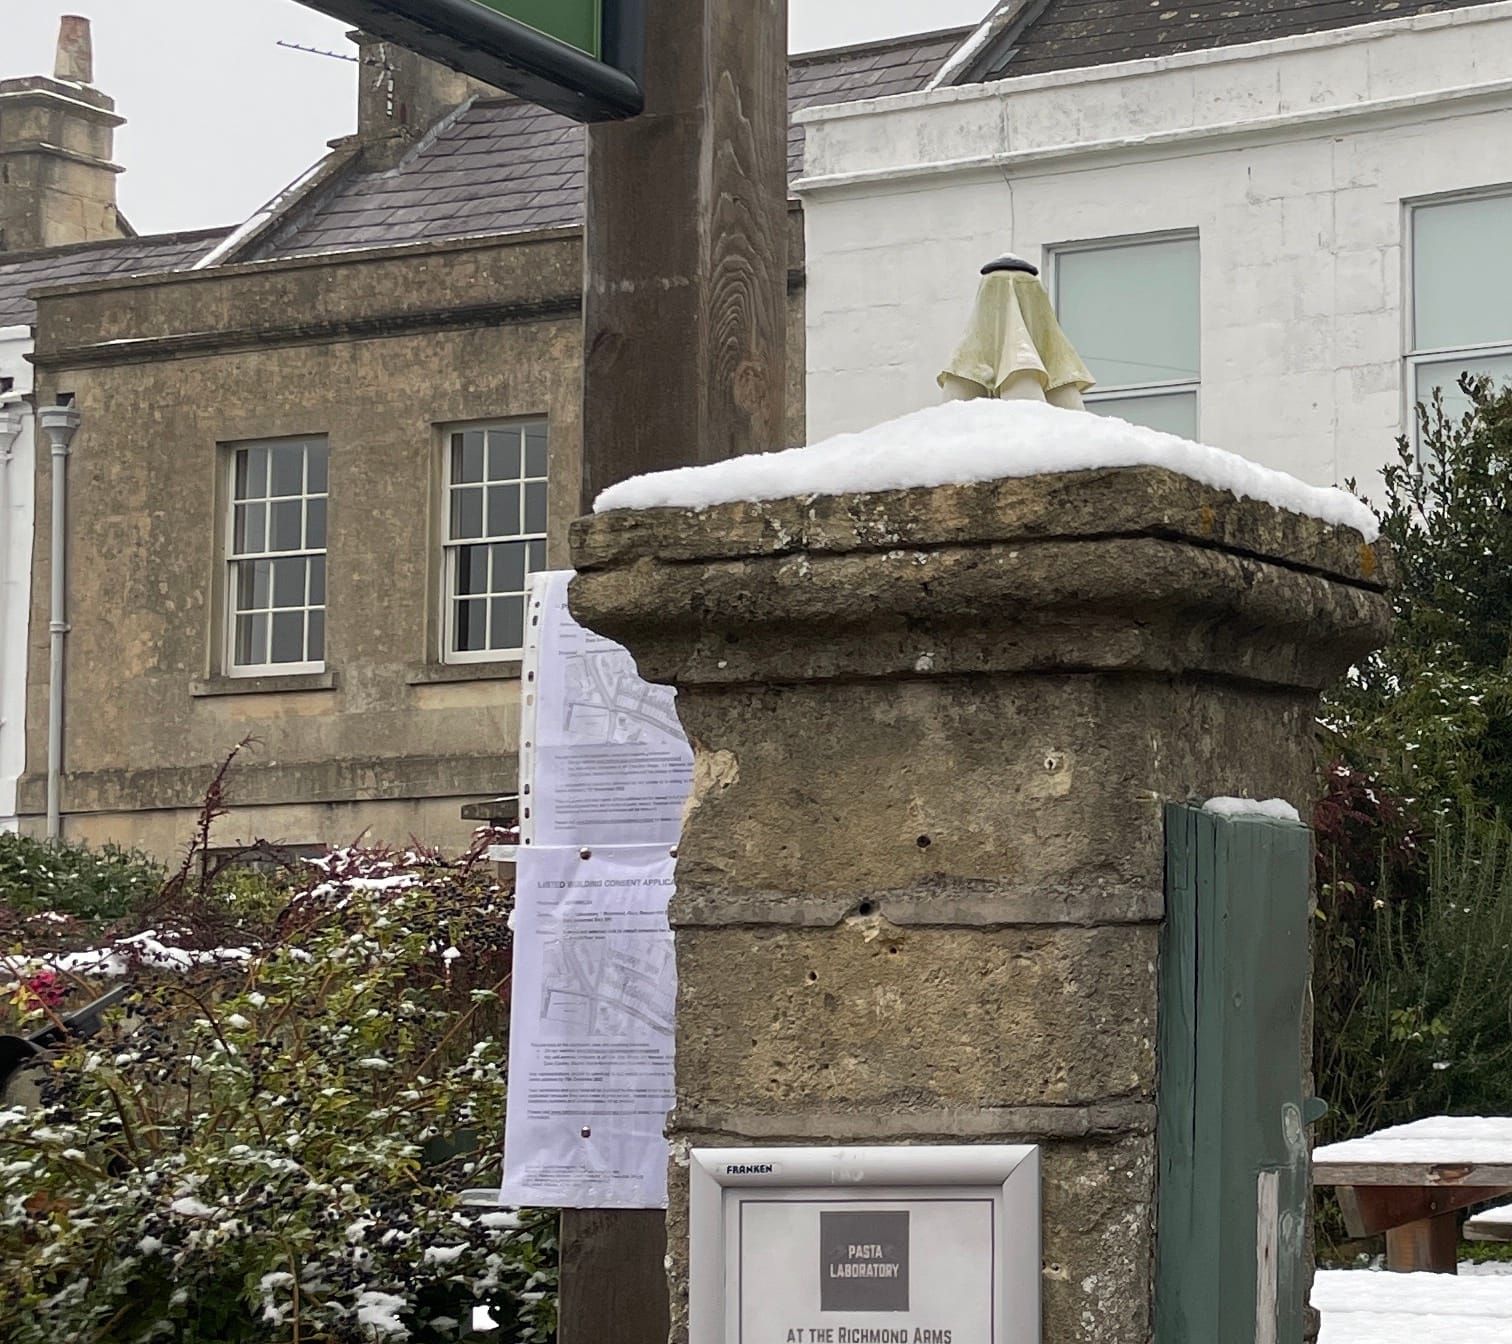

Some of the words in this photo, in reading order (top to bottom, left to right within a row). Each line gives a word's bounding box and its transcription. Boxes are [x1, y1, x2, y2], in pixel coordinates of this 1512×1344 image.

[726, 1164, 773, 1175] FRANKEN
[848, 1244, 883, 1259] PASTA
[830, 1263, 900, 1278] LABORATORY
[786, 1328, 804, 1344] AT
[809, 1328, 834, 1344] THE
[838, 1327, 908, 1344] RICHMOND
[913, 1327, 952, 1344] ARMS
